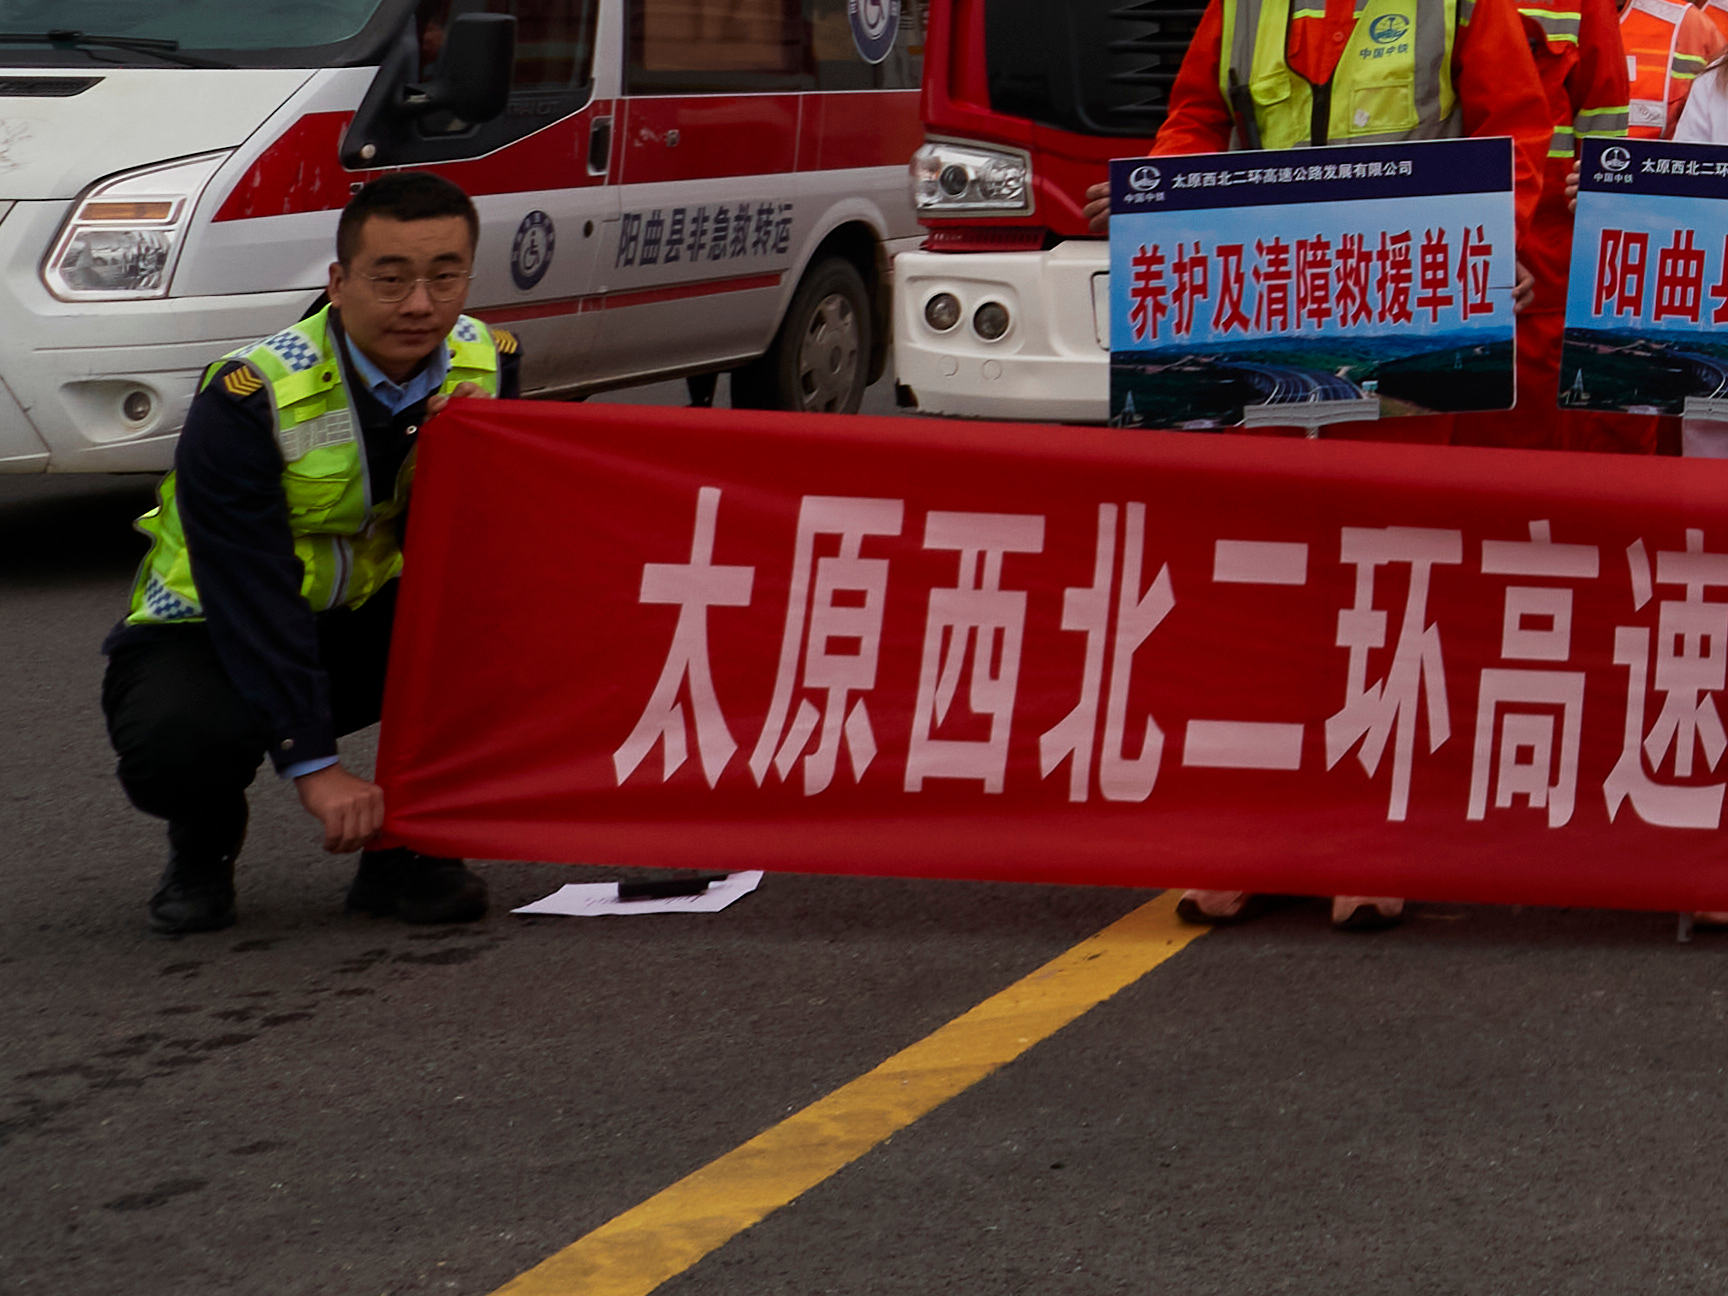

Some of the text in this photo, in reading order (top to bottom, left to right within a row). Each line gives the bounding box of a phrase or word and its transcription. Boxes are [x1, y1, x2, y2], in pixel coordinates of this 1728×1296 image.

[1358, 42, 1410, 60] 中国中铁
[615, 204, 794, 268] 阳曲县非急救转运
[1129, 223, 1494, 342] 养护及清障救援单位
